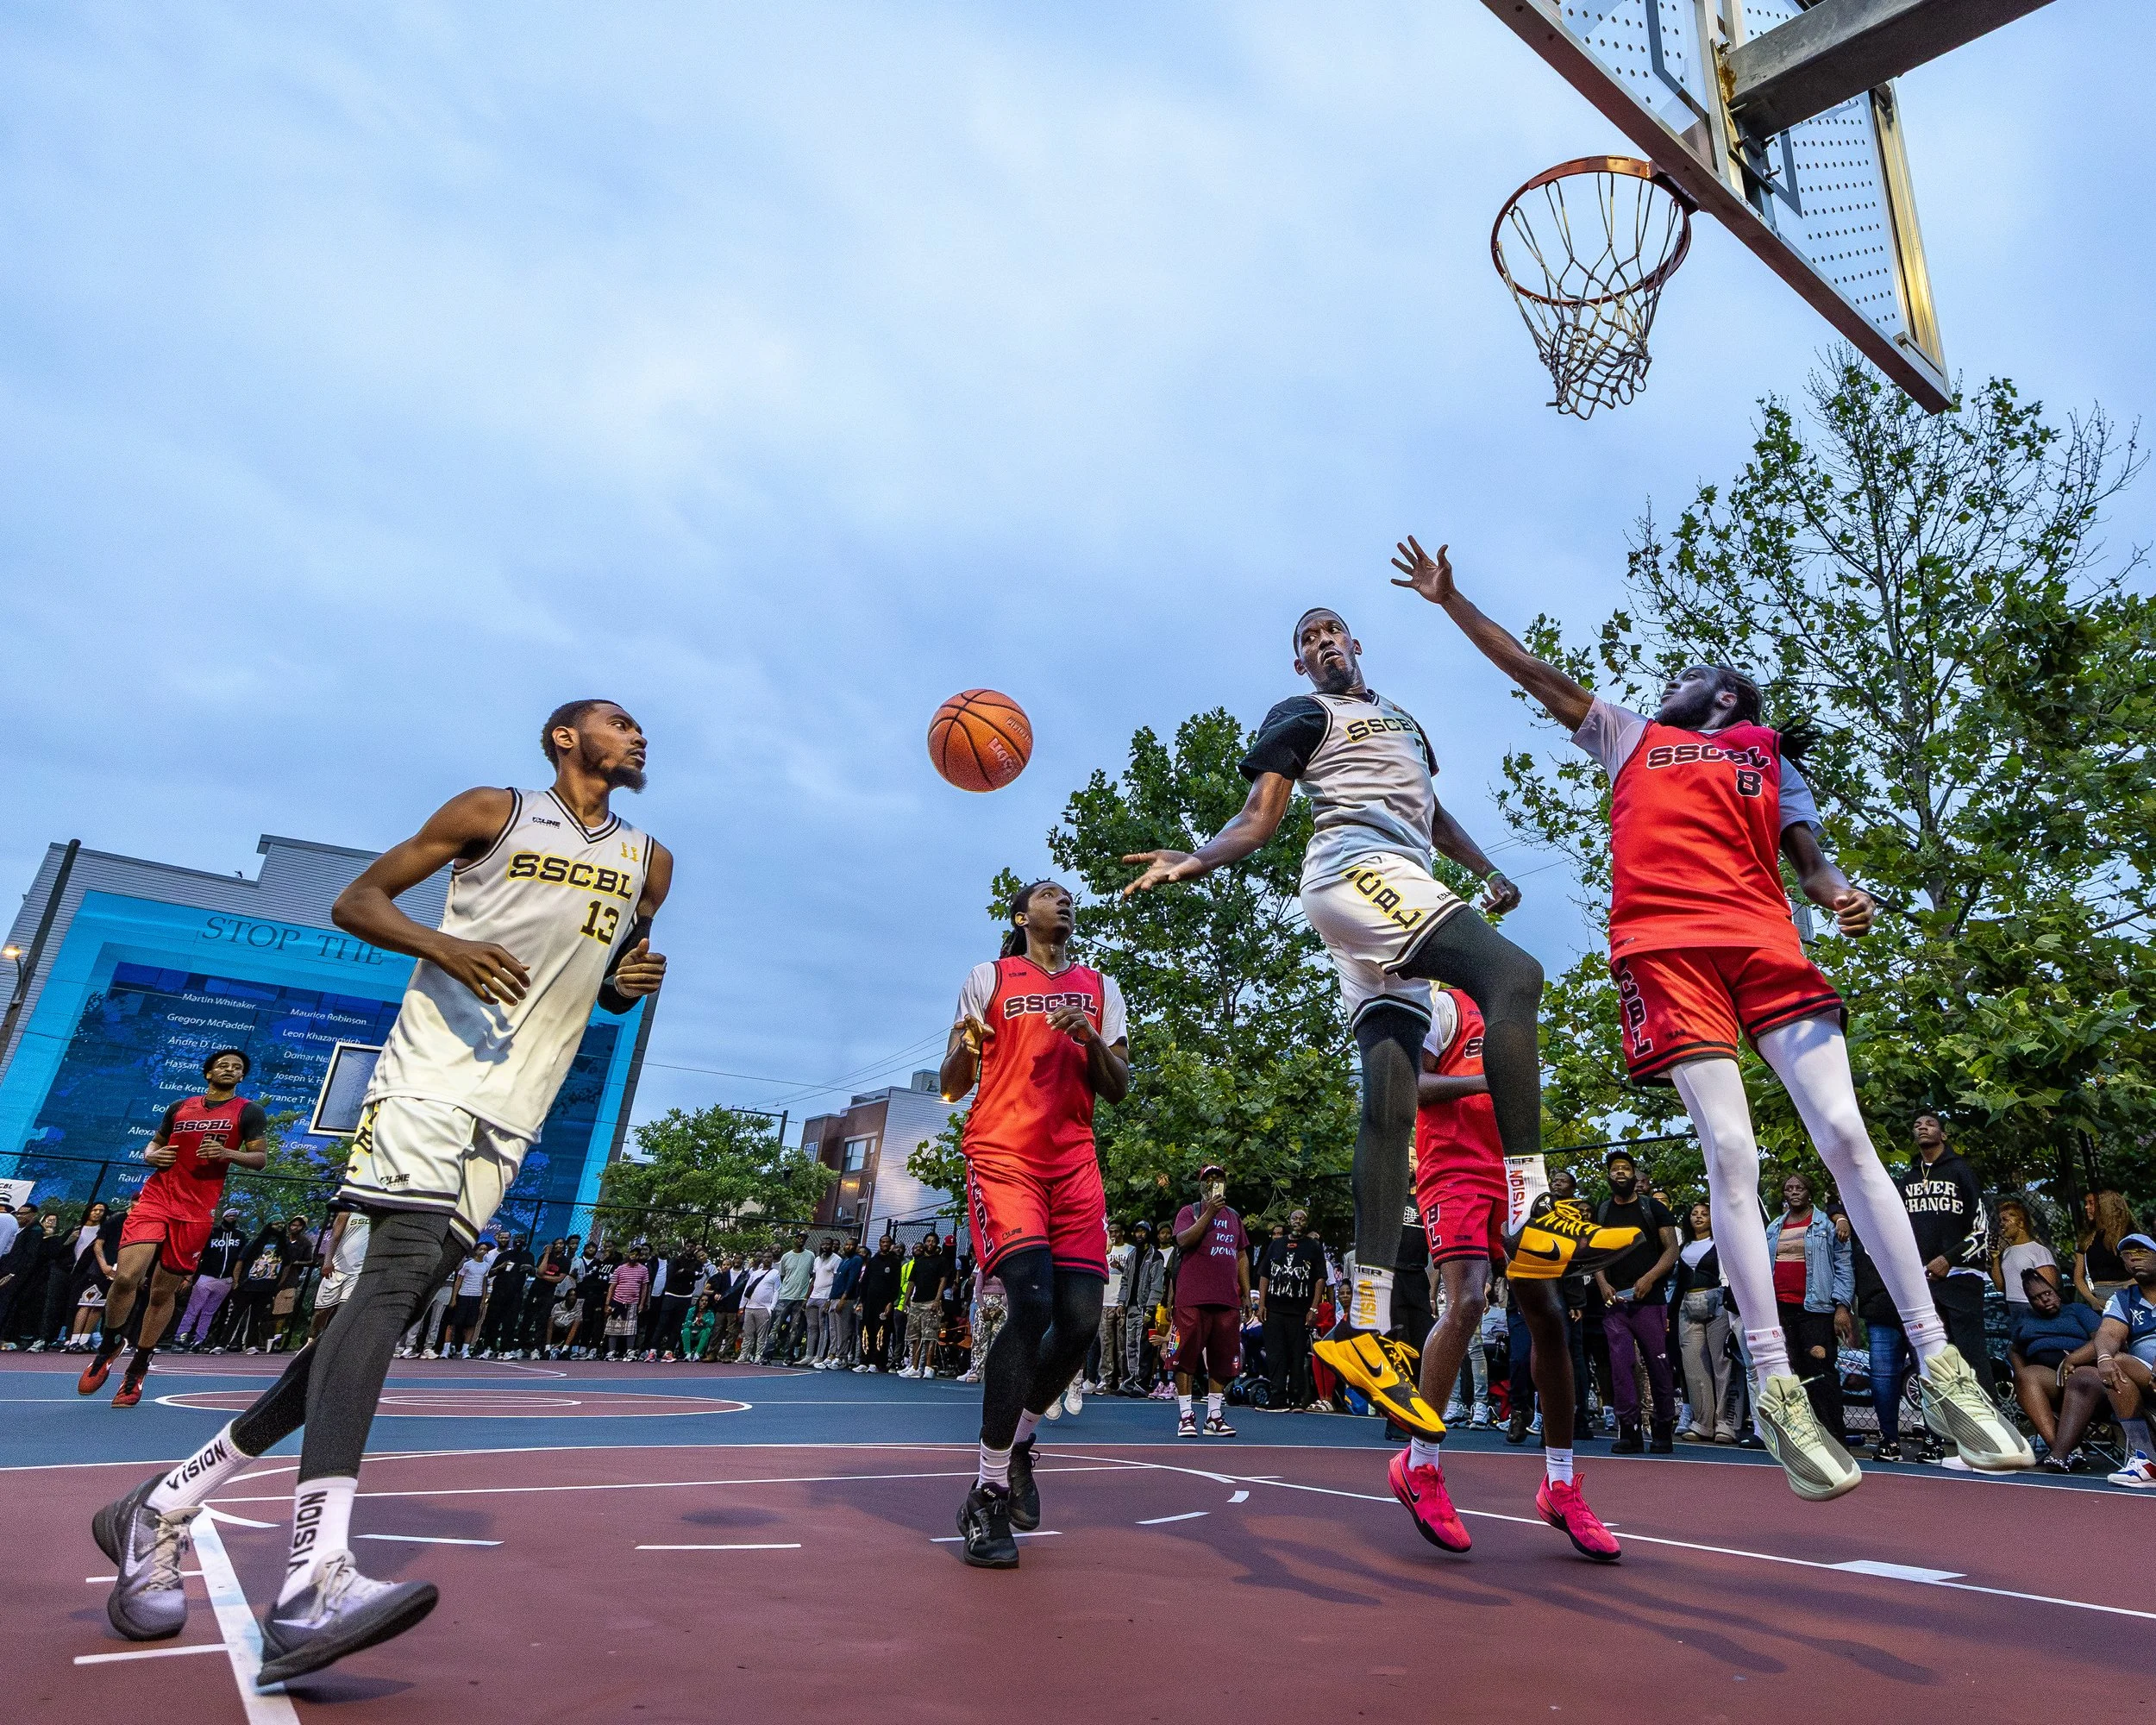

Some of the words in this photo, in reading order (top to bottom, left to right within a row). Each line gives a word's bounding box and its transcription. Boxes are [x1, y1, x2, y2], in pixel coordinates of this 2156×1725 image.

[1646, 743, 1771, 770] SSCBL
[1735, 768, 1763, 798] 8
[505, 850, 635, 901] SSCBL
[580, 899, 620, 945] 13
[202, 916, 301, 950] STOP
[317, 934, 385, 966] THE
[181, 993, 214, 1004] Martin
[215, 997, 256, 1010] Whitaker
[1004, 992, 1099, 1019] SSCBL
[166, 1013, 206, 1026] Gregory
[206, 1018, 255, 1032] McFadden
[290, 1008, 326, 1020] Maurice
[326, 1013, 367, 1026] Robinson
[167, 1036, 198, 1047] Andre
[199, 1039, 210, 1049] D.
[282, 1028, 304, 1038] Leon
[305, 1032, 361, 1045] Khazanovich
[165, 1058, 199, 1070] Hassan
[283, 1051, 314, 1062] Domar
[159, 1081, 184, 1091] Luke
[274, 1072, 306, 1083] Joseph
[172, 1119, 234, 1134] SSCBL
[118, 1173, 141, 1183] Raul
[1905, 1180, 1958, 1198] NEVER
[1905, 1195, 1964, 1214] HANGE
[210, 1239, 241, 1249] KORS
